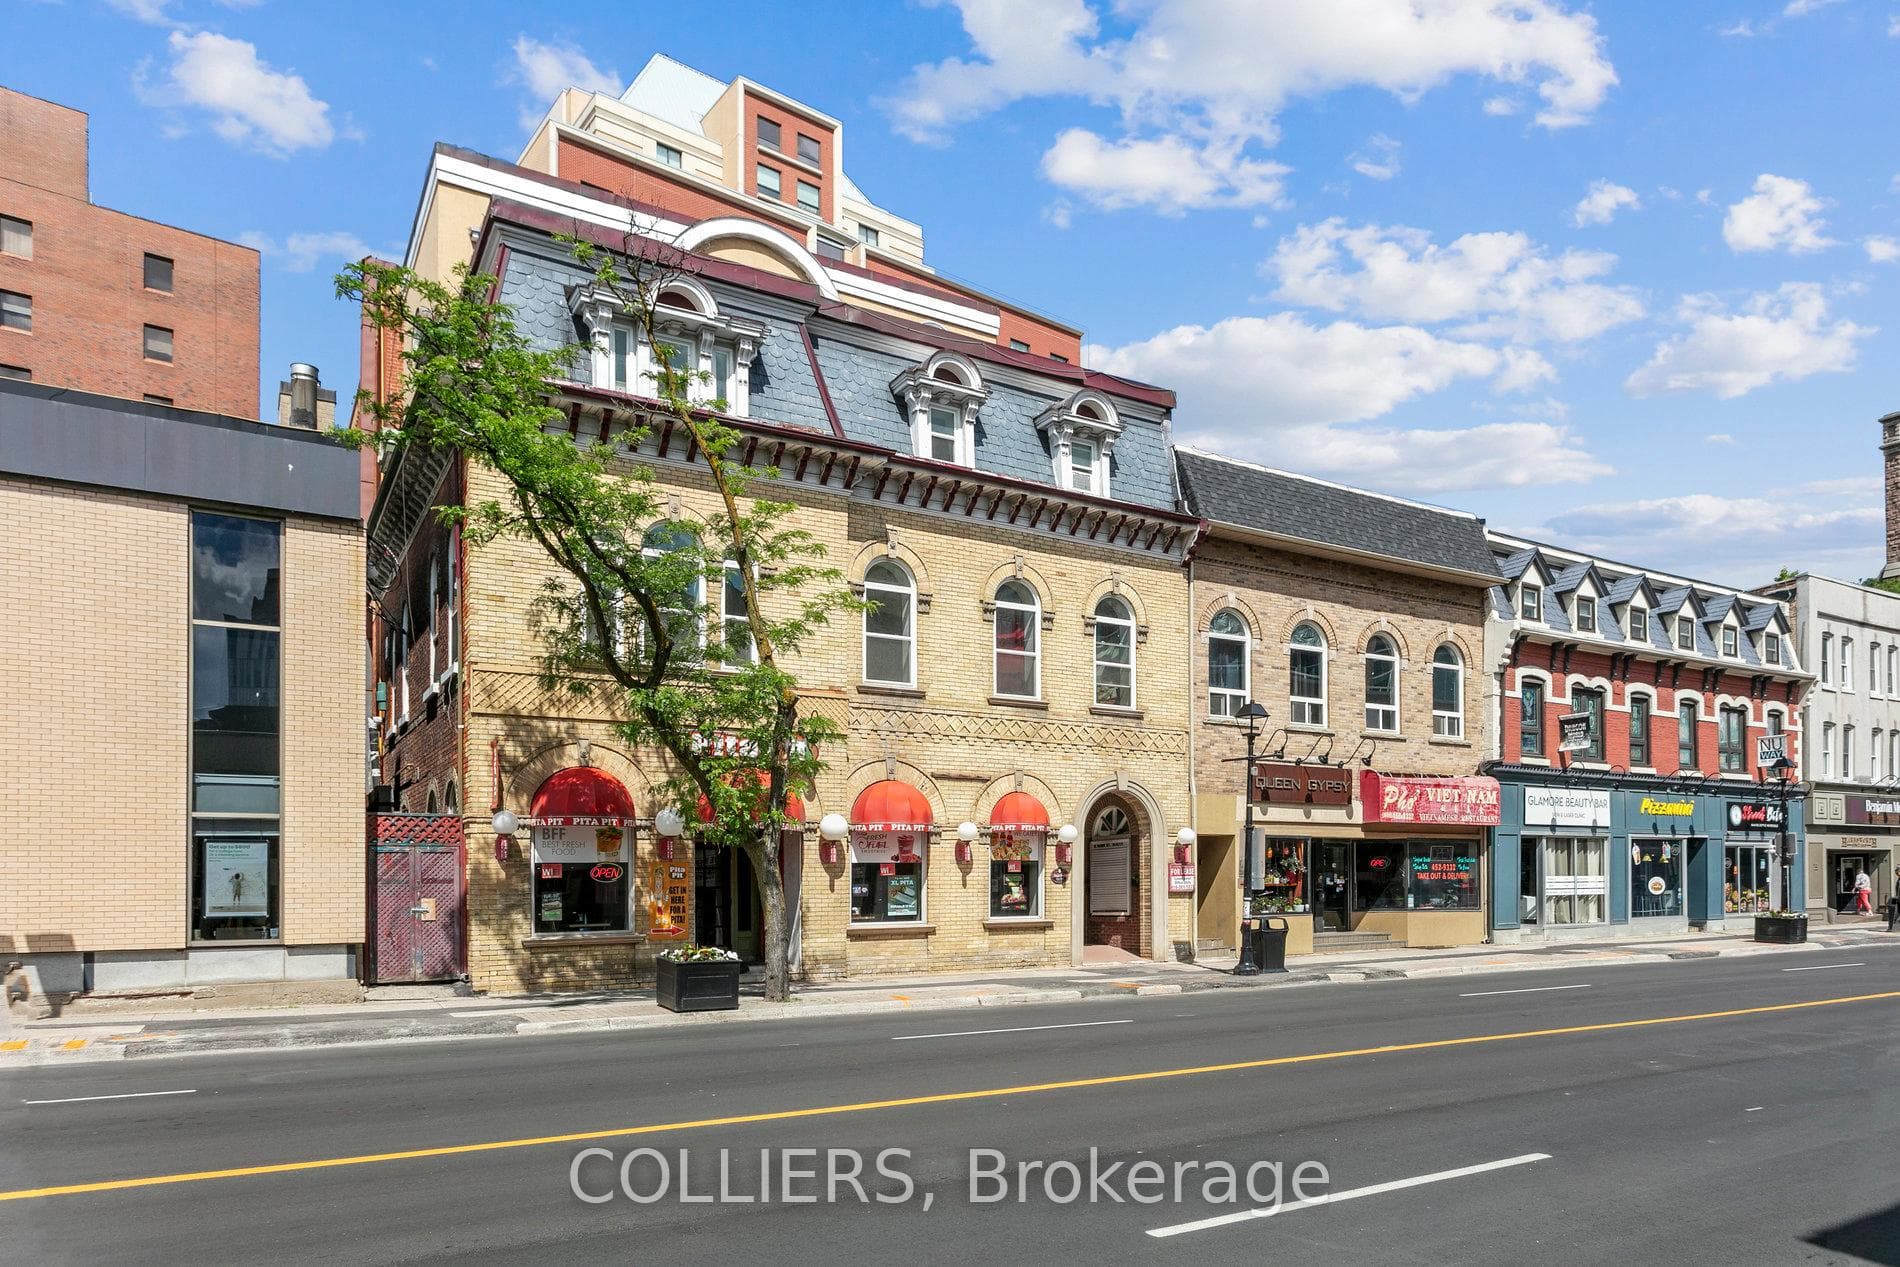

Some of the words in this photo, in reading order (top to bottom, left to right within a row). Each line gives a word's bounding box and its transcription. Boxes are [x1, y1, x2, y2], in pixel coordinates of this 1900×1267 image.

[1760, 737, 1782, 751] NU
[1761, 751, 1782, 759] WAY
[1255, 777, 1301, 790] QUEEN
[1308, 779, 1352, 793] GYPSY
[1426, 788, 1461, 803] VIET
[1467, 790, 1498, 805] NAM
[1528, 795, 1564, 807] GLAMORE
[1565, 797, 1594, 808] BEAUTY
[1593, 799, 1608, 808] BAR
[1865, 799, 1893, 815] Benjamin
[547, 818, 564, 826] PIT
[573, 818, 599, 826] PITA
[601, 818, 618, 826] PIT
[542, 828, 566, 840] BFF
[541, 840, 559, 848] BEST
[551, 848, 576, 856] FOOD
[591, 865, 620, 878] OPEN
[1417, 872, 1429, 880] TAKE
[1430, 872, 1441, 880] OUT
[1442, 872, 1447, 880] &
[669, 886, 679, 894] GET
[671, 895, 685, 904] HERE
[670, 906, 681, 914] FOR
[682, 905, 686, 913] A
[671, 915, 686, 924] PITA!
